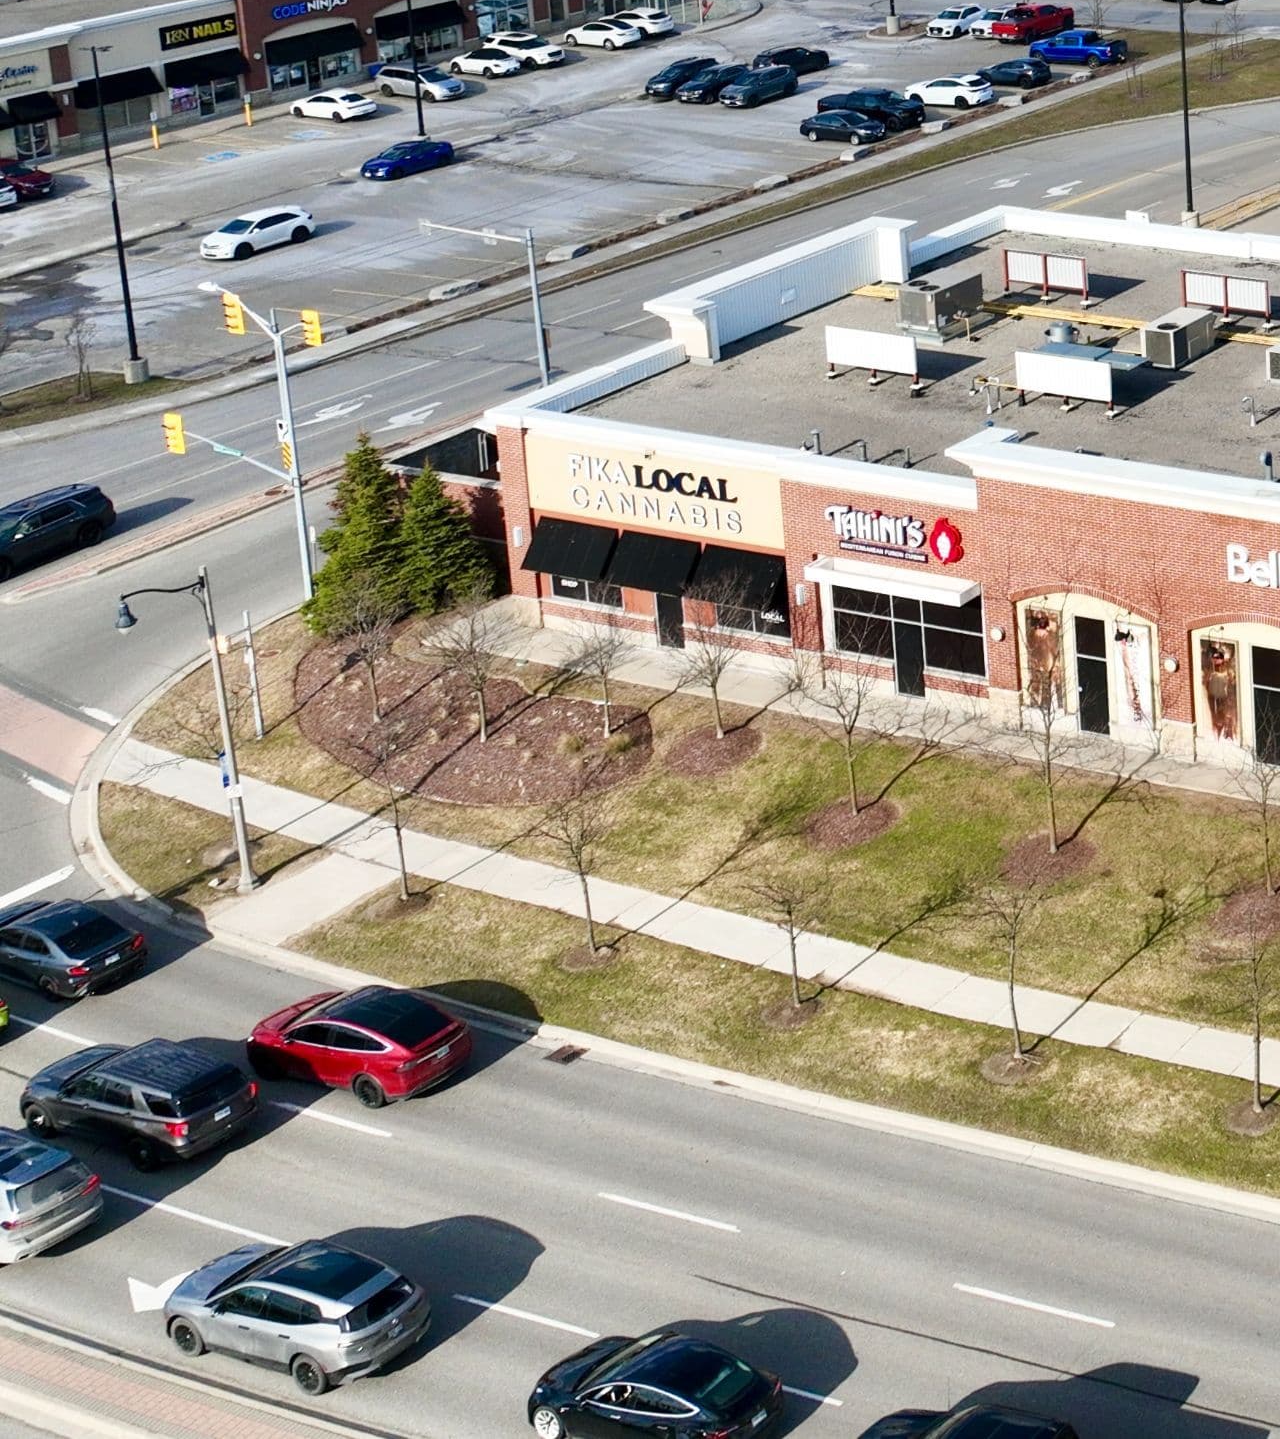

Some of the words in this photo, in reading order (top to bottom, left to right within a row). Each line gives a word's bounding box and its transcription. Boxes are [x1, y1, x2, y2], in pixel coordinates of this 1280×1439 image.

[272, 2, 306, 20] CODE
[192, 19, 236, 39] NAILS
[632, 464, 738, 504] LOCAL
[571, 484, 743, 535] CANNABIS
